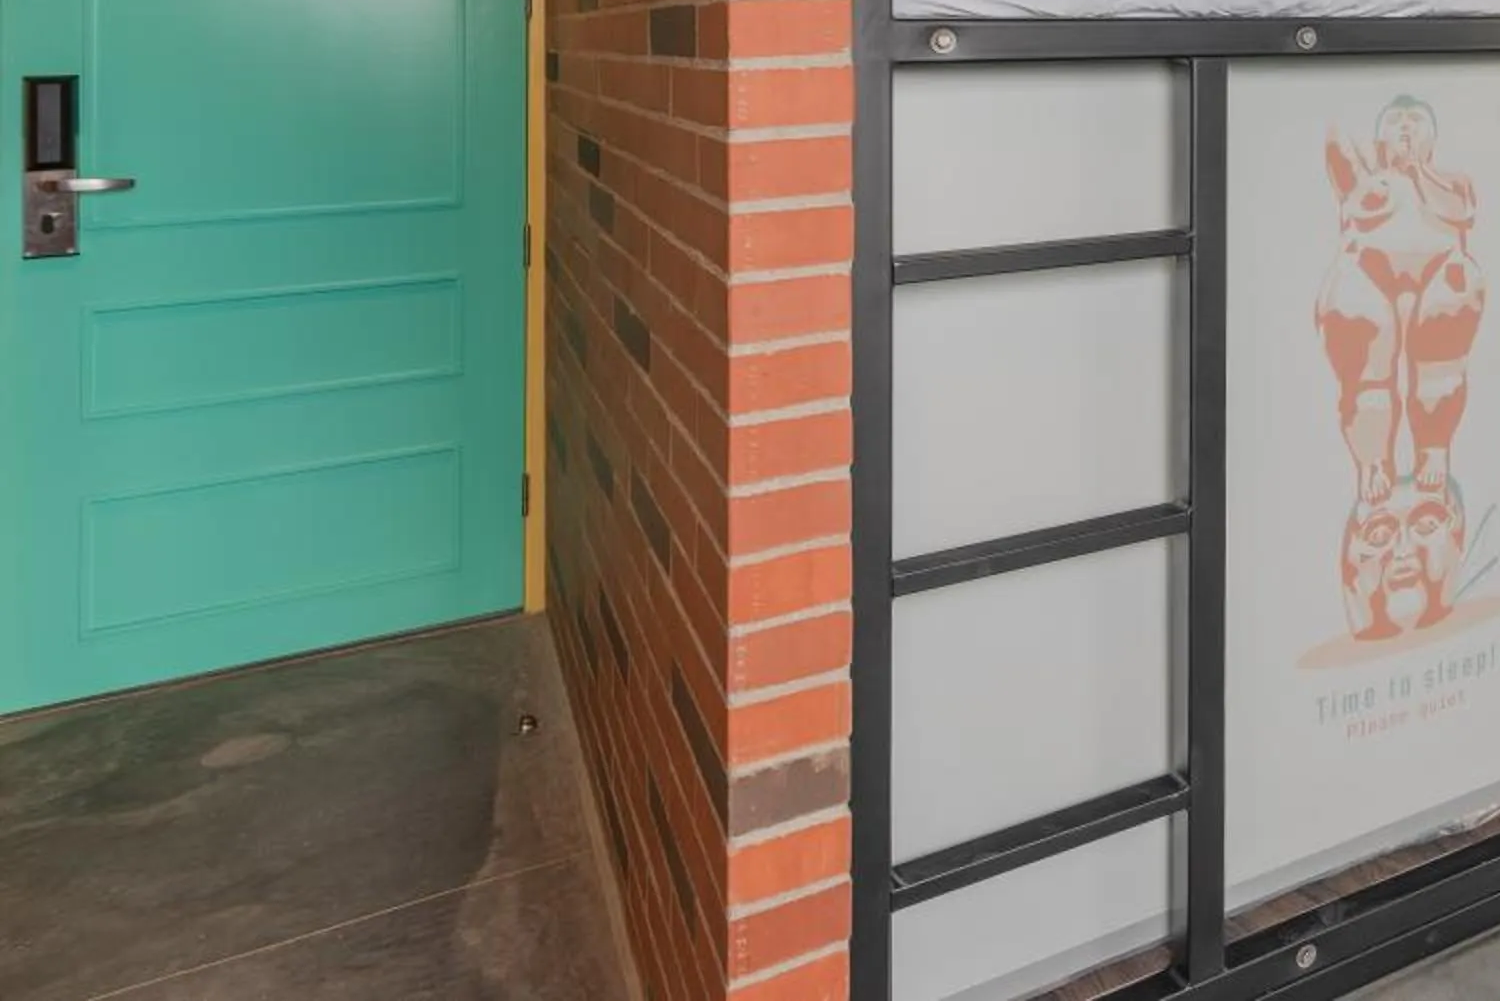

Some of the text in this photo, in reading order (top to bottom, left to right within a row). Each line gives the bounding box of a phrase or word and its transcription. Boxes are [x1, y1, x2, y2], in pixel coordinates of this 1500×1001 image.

[1315, 643, 1496, 725] Time to sleep!
